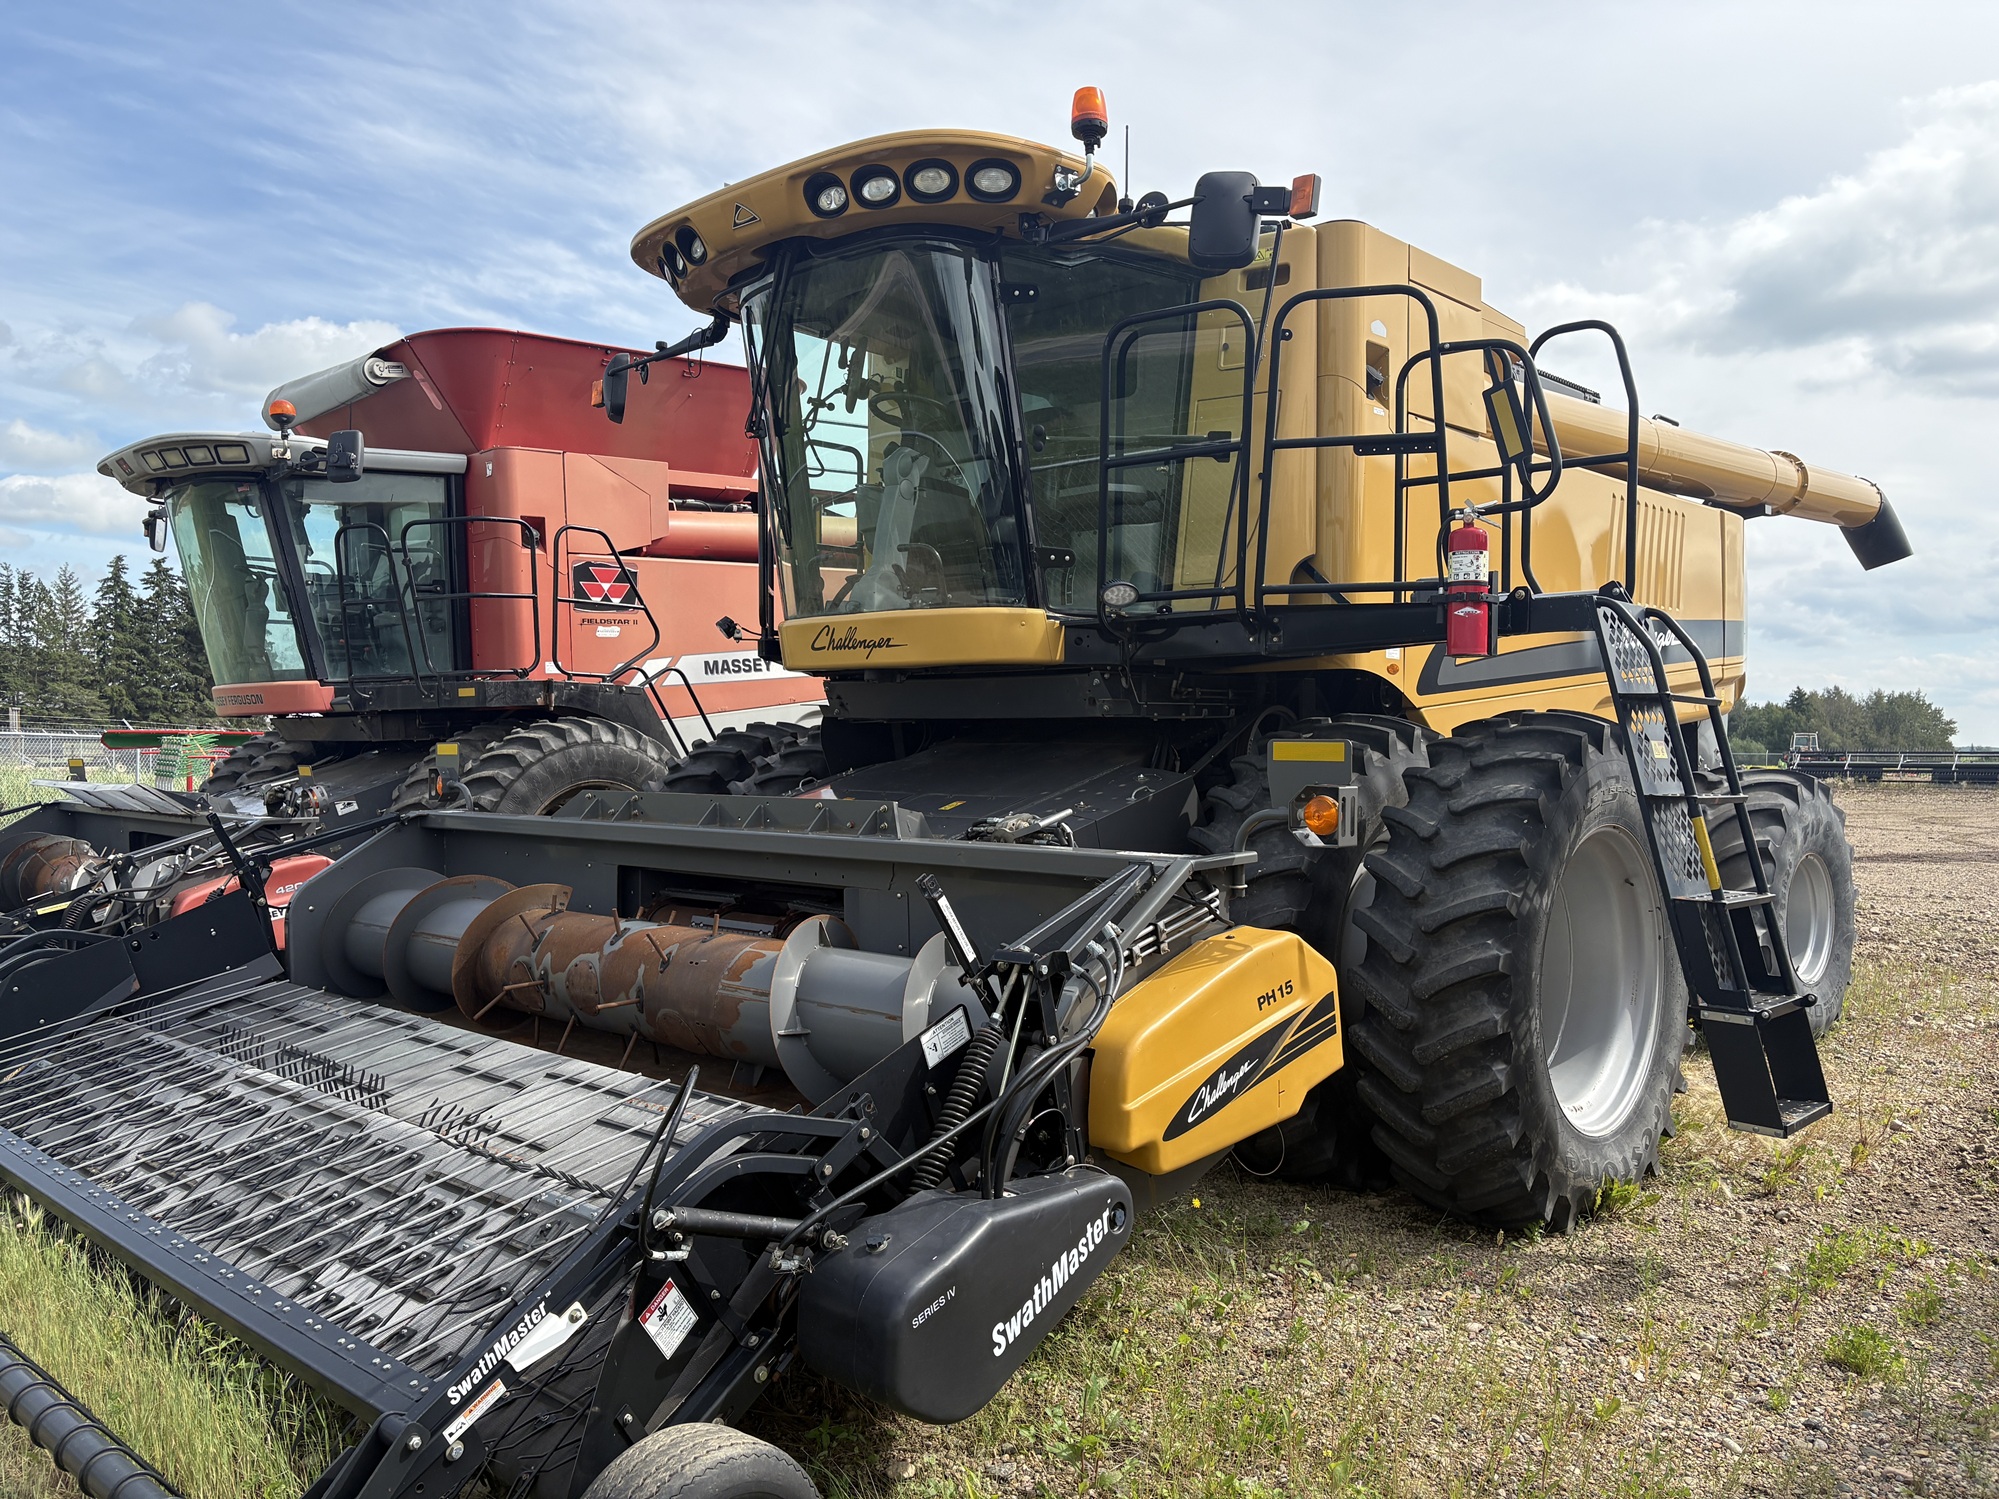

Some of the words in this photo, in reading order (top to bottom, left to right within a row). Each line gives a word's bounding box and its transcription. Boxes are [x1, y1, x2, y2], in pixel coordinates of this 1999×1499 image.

[811, 624, 908, 660] Challenger
[703, 658, 771, 676] MASSEY
[228, 693, 264, 706] FERGUSON
[1257, 988, 1277, 1011] PH
[1277, 979, 1294, 999] 15
[931, 1017, 954, 1035] ATTENTION
[1187, 1058, 1259, 1123] Challenger
[992, 1206, 1110, 1357] SwathMaster
[650, 1287, 669, 1311] DANGER
[912, 1296, 946, 1329] SERIES
[946, 1286, 957, 1301] IV
[446, 1300, 548, 1406] SwathMaster
[472, 1384, 497, 1408] WARNING
